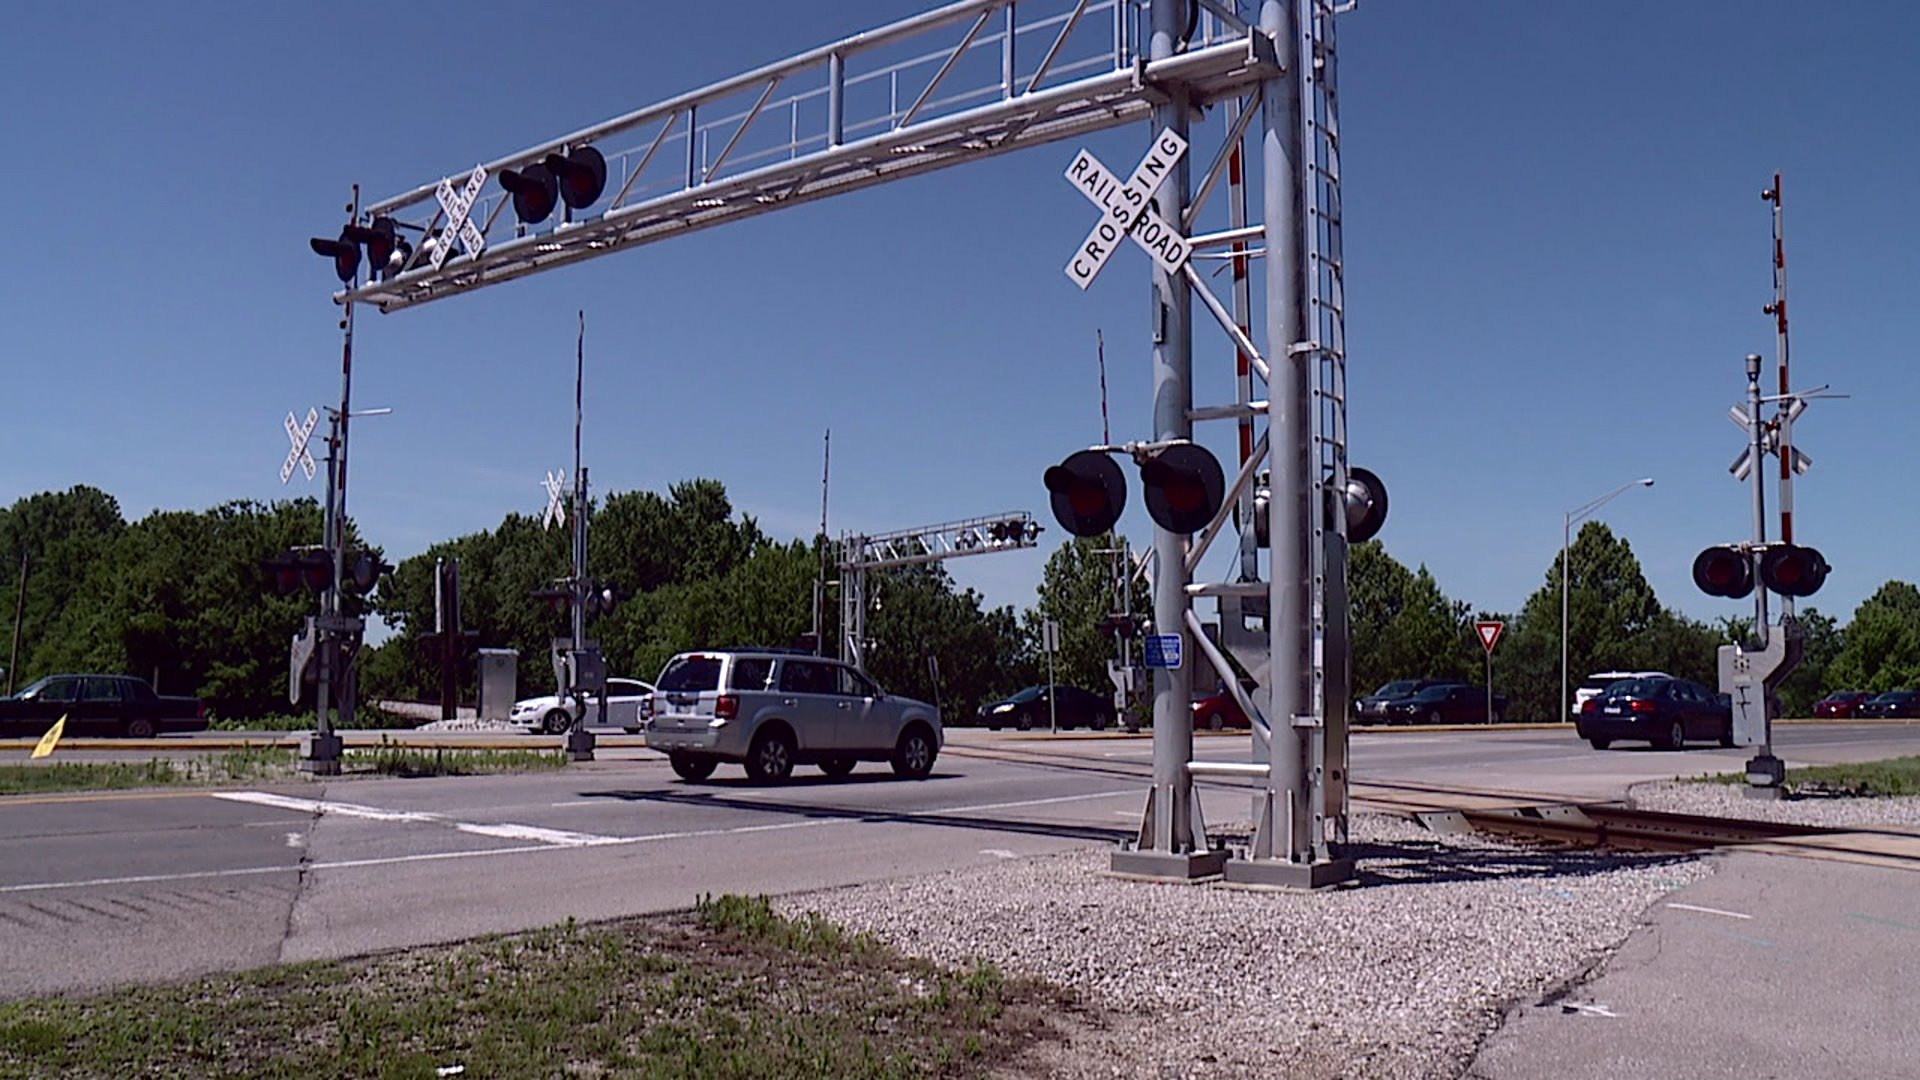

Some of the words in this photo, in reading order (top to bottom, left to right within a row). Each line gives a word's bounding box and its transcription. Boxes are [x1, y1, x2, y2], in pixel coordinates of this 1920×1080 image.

[433, 170, 483, 263] CROSSING
[1071, 156, 1117, 208] RAIL
[1136, 212, 1183, 264] ROAD
[1074, 138, 1178, 278] CROSSING
